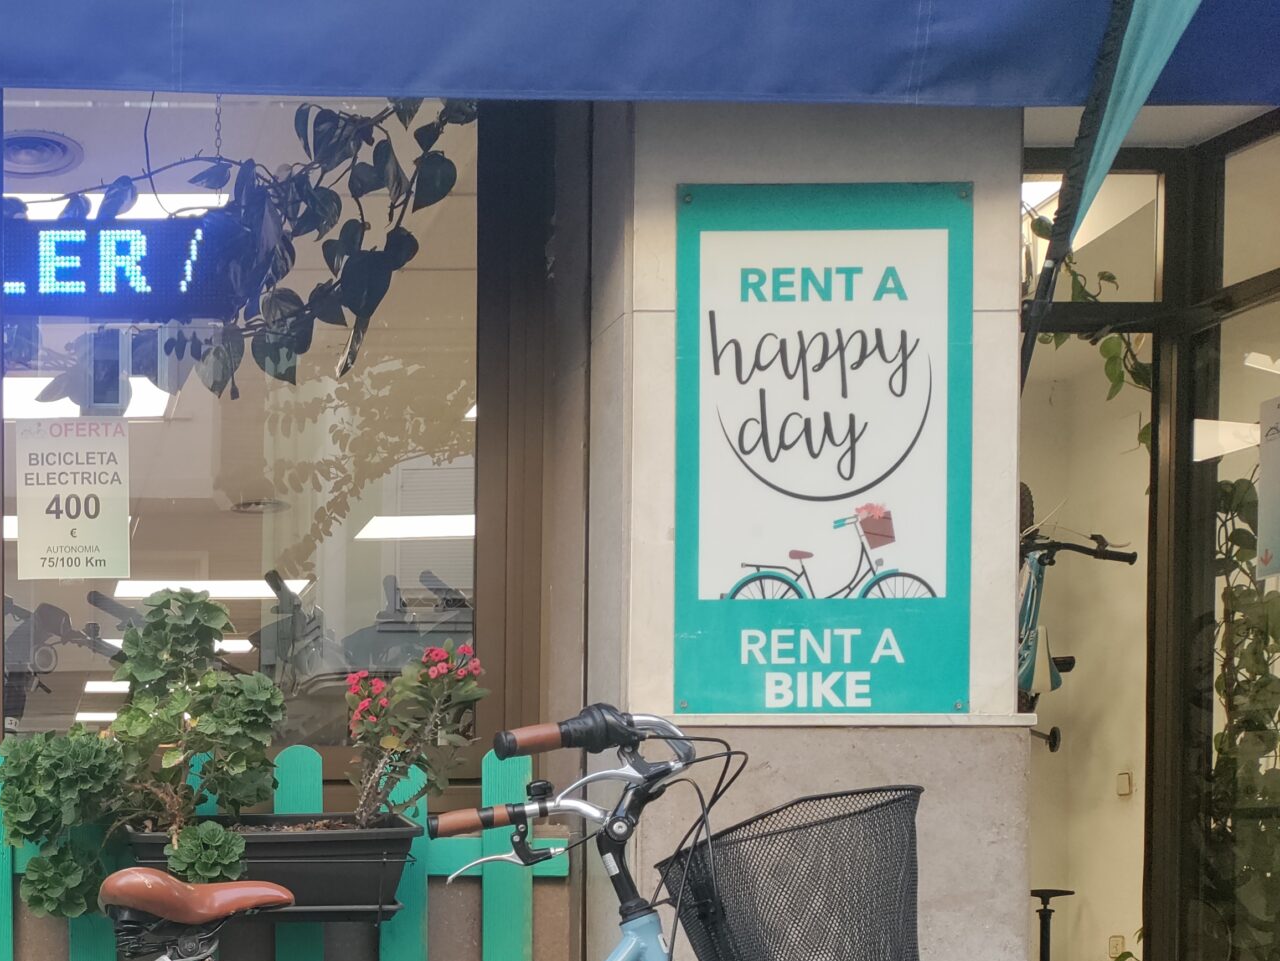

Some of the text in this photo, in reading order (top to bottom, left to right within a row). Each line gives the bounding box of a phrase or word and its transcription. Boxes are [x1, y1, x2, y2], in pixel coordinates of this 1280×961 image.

[740, 266, 908, 302] RENT A
[709, 310, 920, 401] happy
[49, 422, 125, 438] OFERTA
[738, 388, 868, 481] day
[28, 452, 118, 466] BICICLETA
[24, 471, 122, 486] ELECTRICA
[46, 493, 101, 520] 400
[70, 528, 77, 538] €
[46, 545, 101, 554] AUTONOMIA
[40, 557, 107, 568] 75/100 Km
[740, 628, 905, 665] RENT A
[764, 671, 872, 708] BIKE
